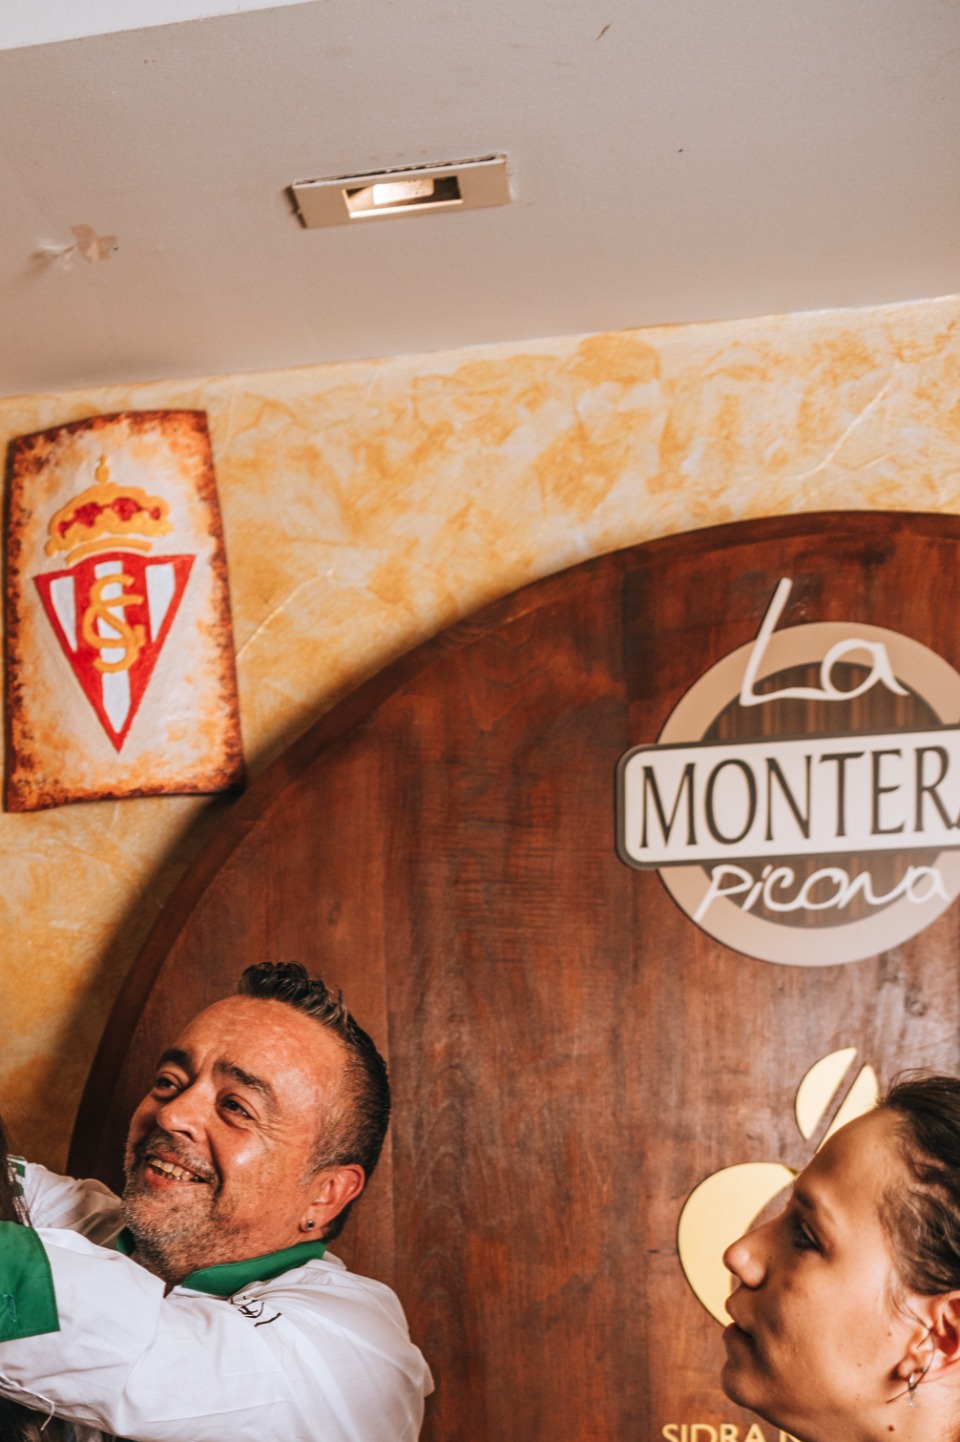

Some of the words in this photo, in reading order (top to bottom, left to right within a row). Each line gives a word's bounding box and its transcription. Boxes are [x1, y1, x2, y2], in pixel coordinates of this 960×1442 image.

[739, 577, 910, 706] La
[639, 745, 960, 849] MONTER
[692, 865, 952, 922] Picona
